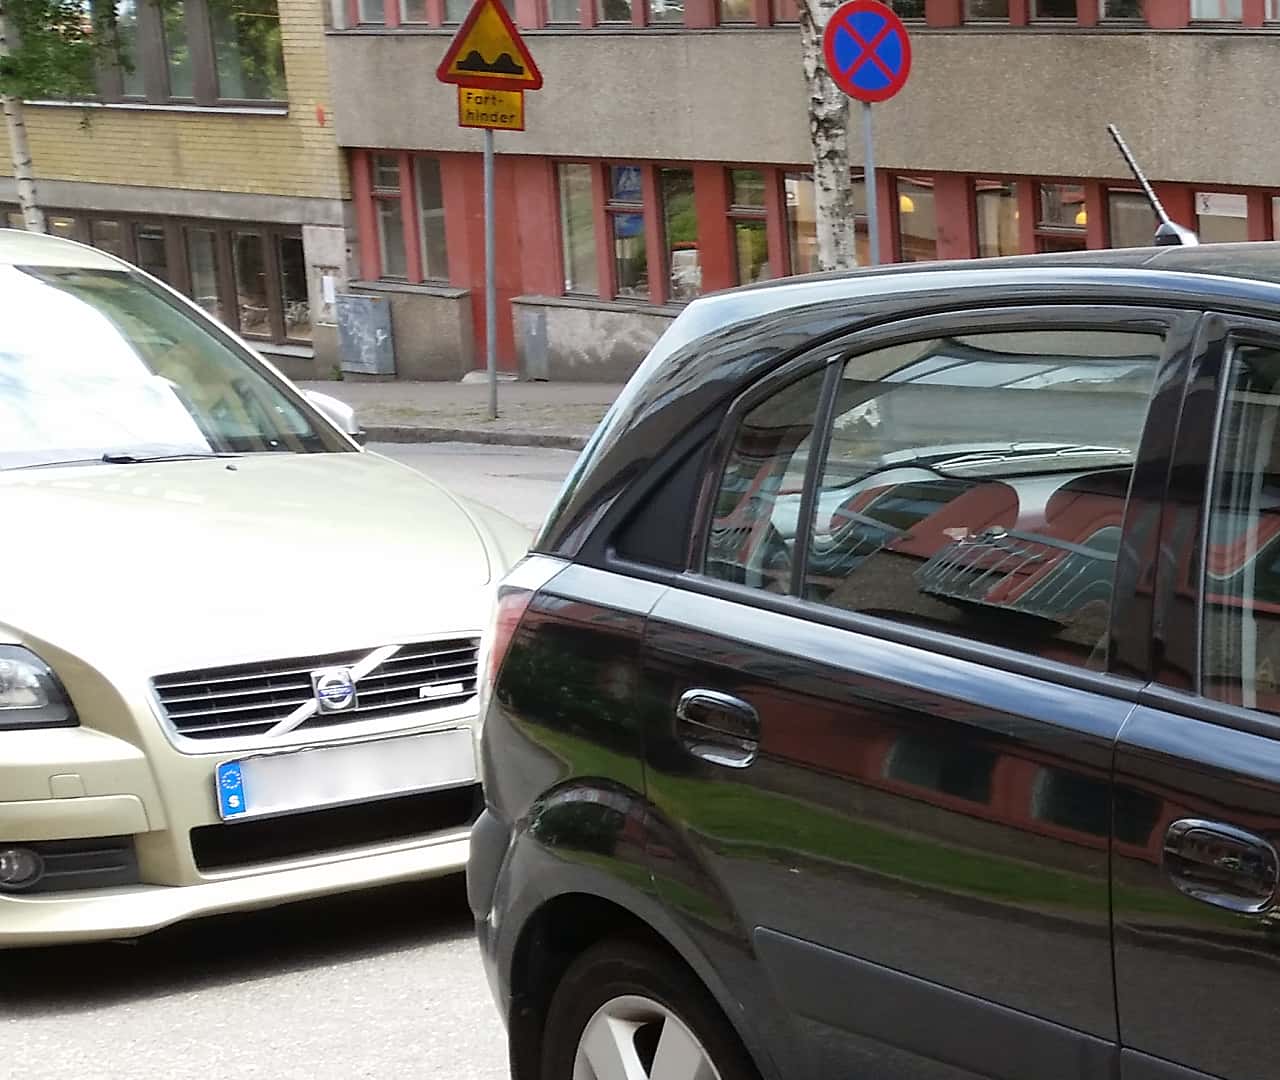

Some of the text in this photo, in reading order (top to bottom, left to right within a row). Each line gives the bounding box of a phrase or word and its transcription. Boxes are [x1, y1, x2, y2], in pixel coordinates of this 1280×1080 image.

[466, 92, 503, 106] Fart-
[466, 110, 514, 124] hinder
[228, 795, 240, 808] S
